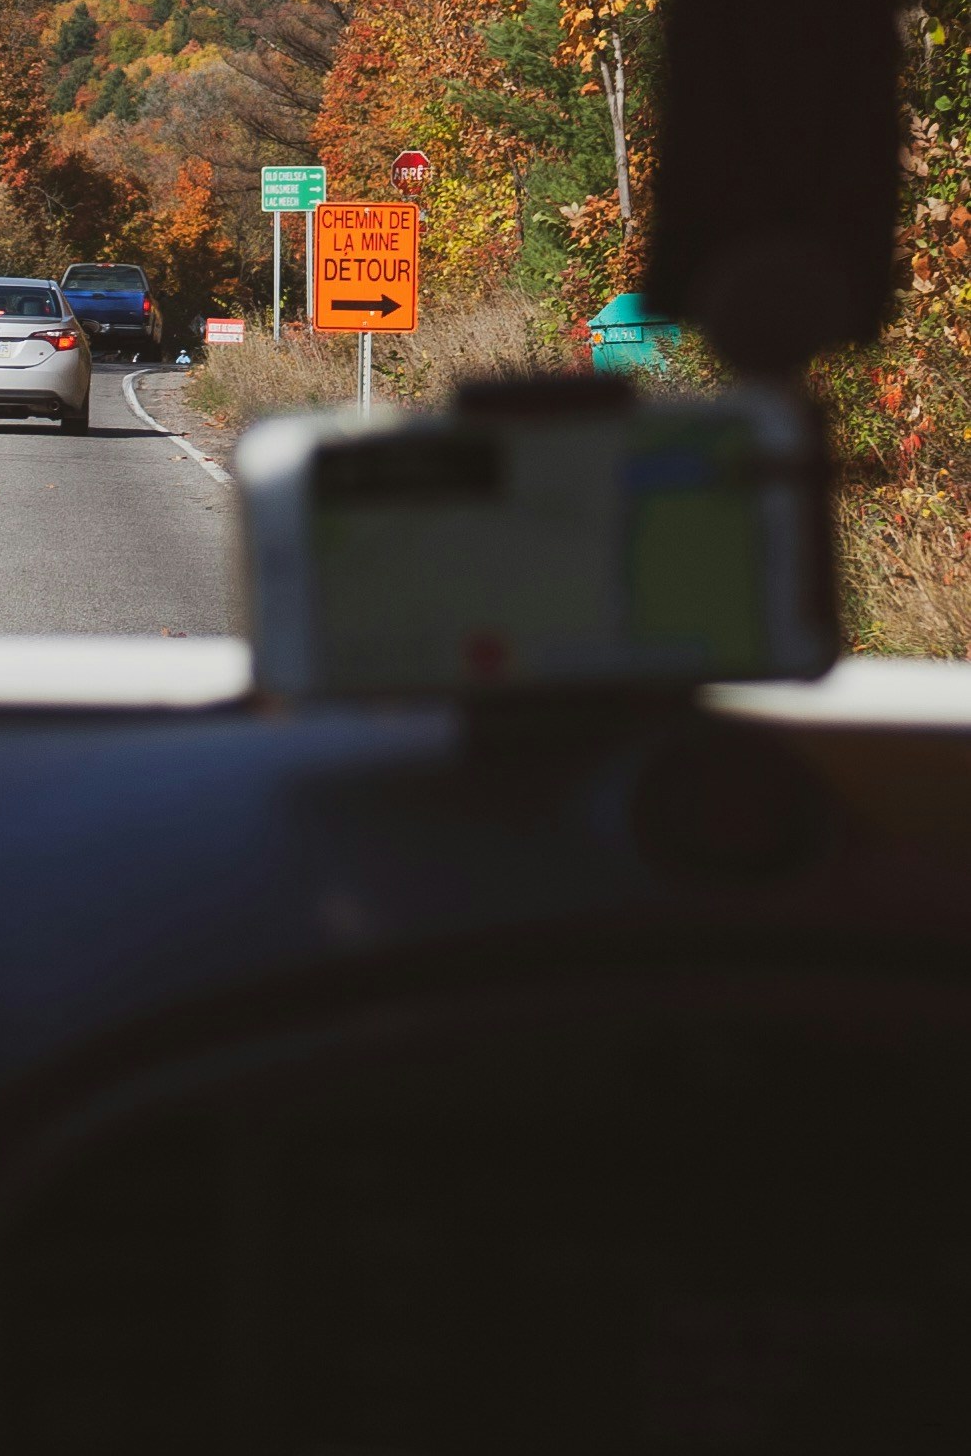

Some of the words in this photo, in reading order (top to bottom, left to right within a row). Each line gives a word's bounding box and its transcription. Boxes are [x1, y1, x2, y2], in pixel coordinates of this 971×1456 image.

[393, 164, 429, 180] ARRÊ
[322, 210, 383, 228] CHEMIN
[389, 211, 410, 229] DE
[333, 233, 354, 251] LA
[361, 232, 399, 251] MINE
